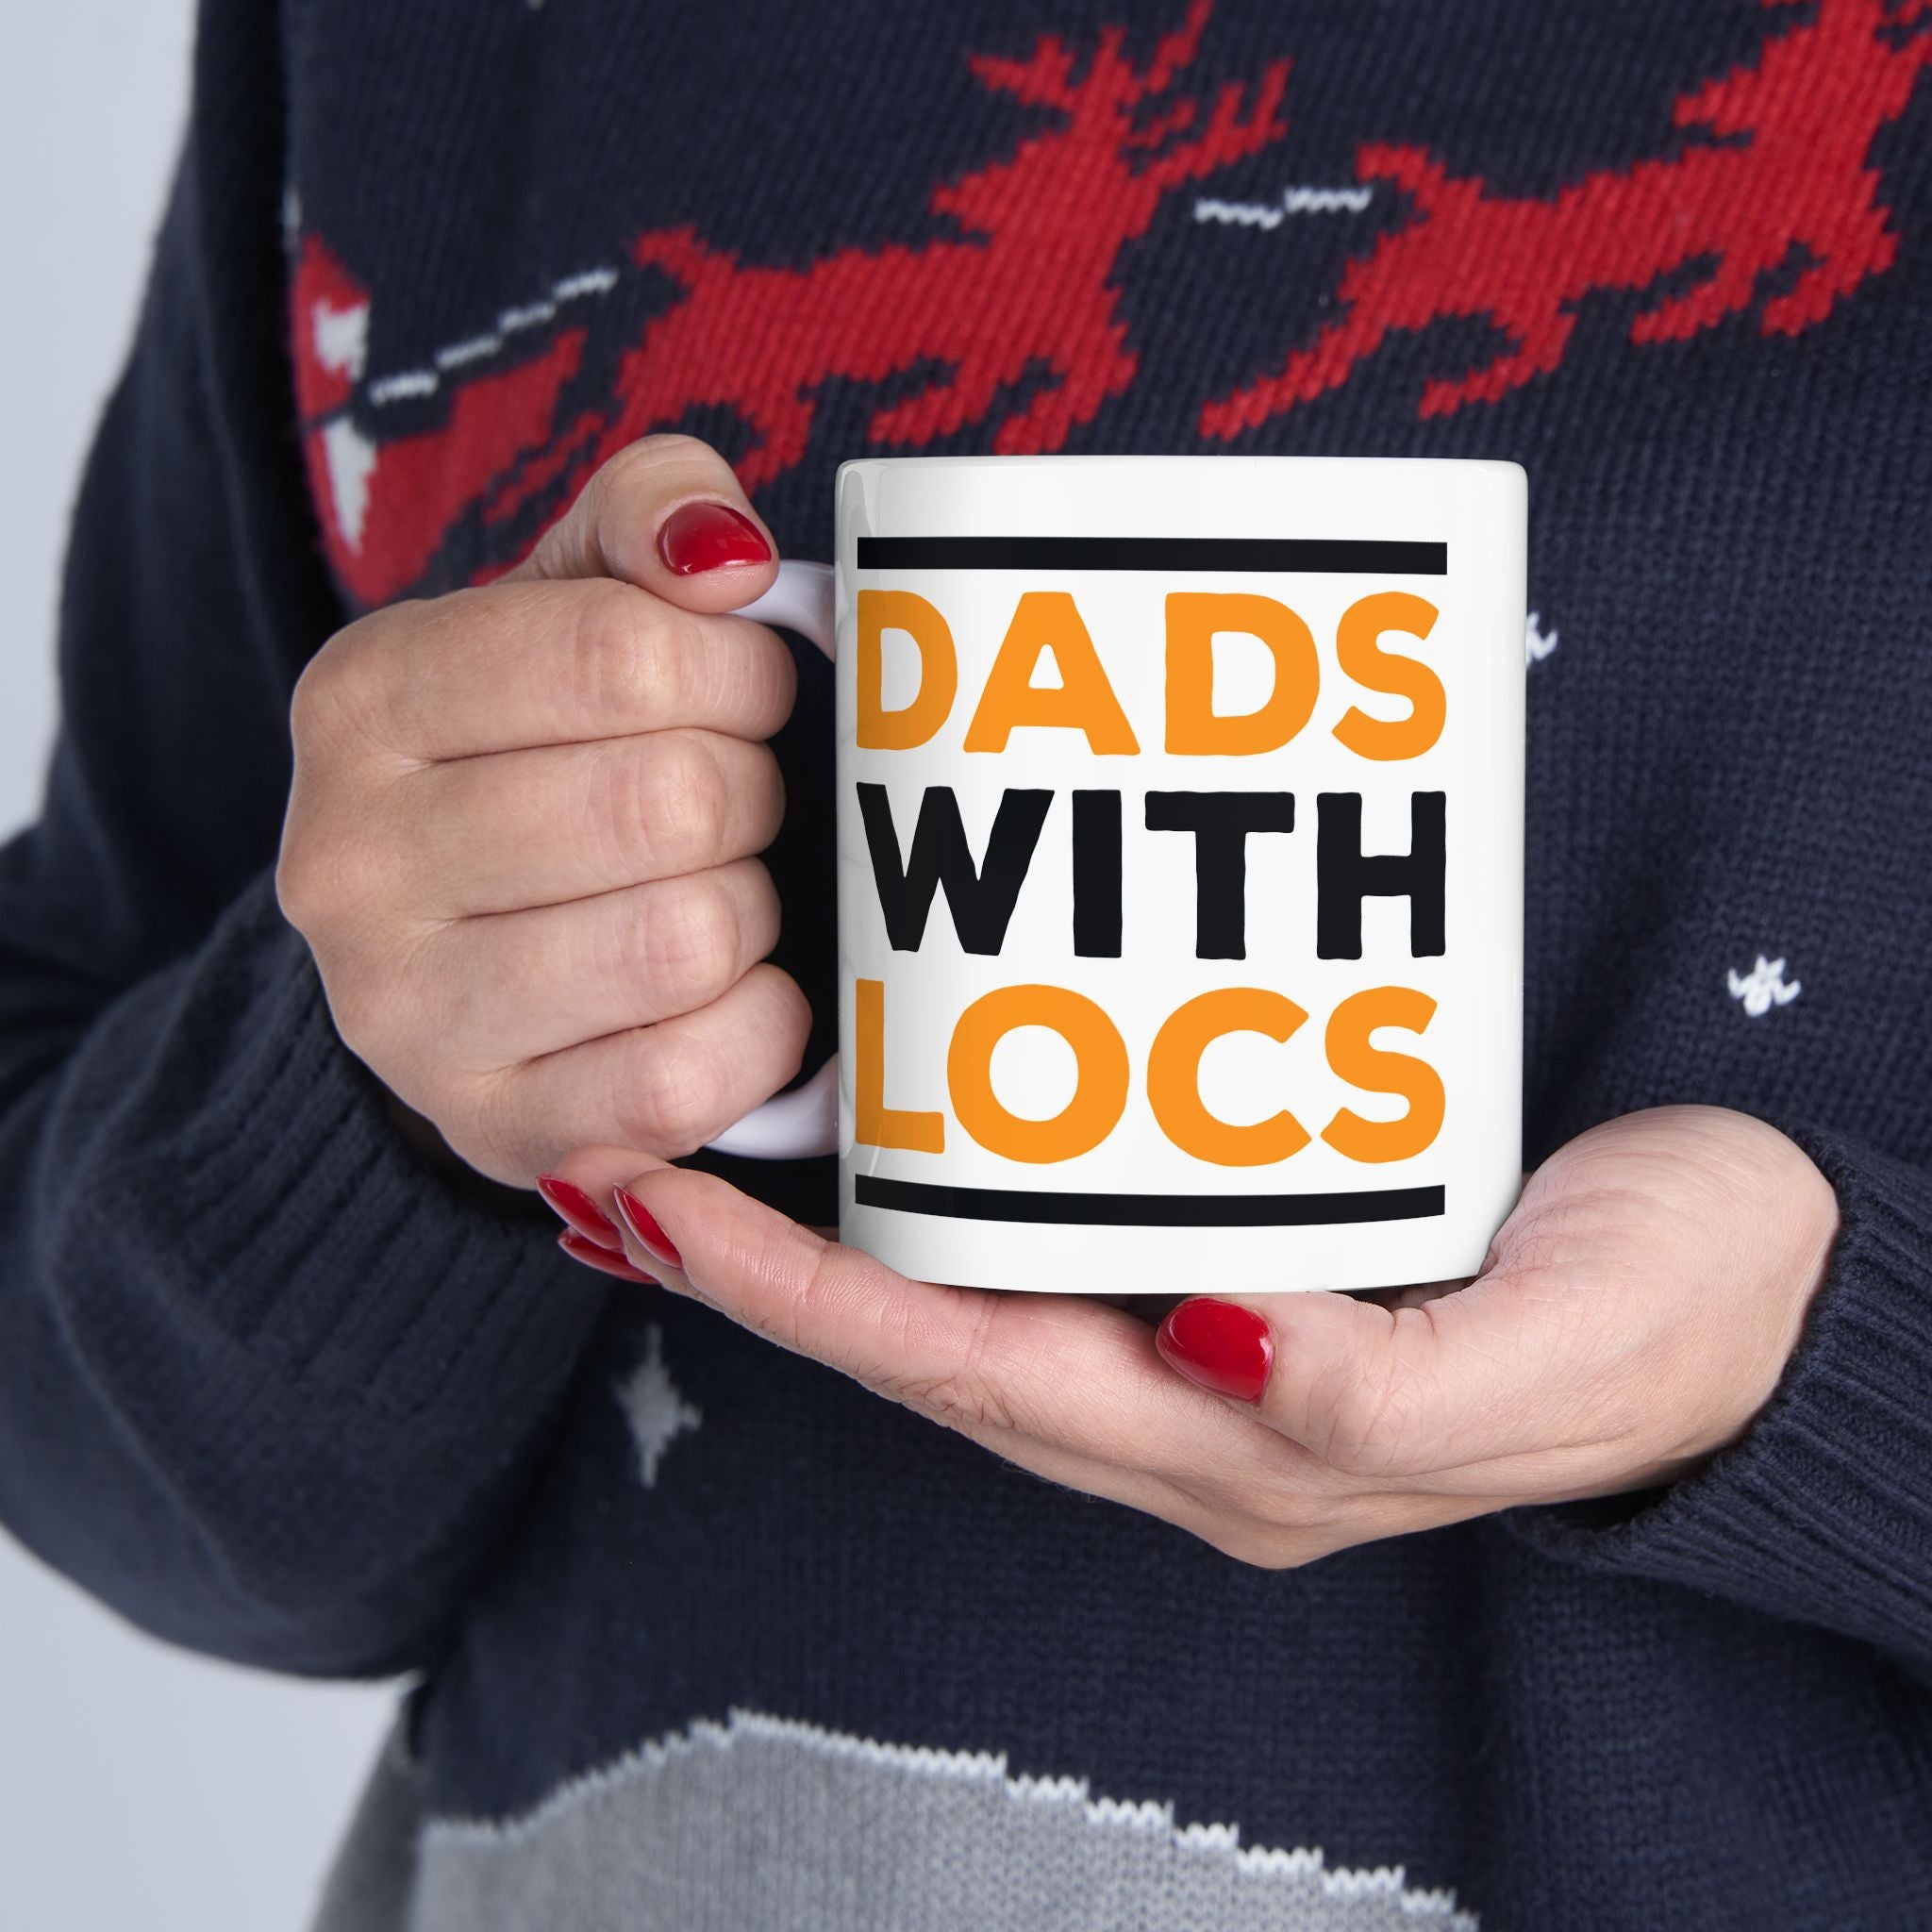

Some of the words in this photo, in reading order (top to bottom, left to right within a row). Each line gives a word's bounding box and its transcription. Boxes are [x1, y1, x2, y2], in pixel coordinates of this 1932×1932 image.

[856, 589, 1447, 761] DADS
[856, 781, 1447, 961] WITH
[855, 977, 1446, 1168] LOCS
